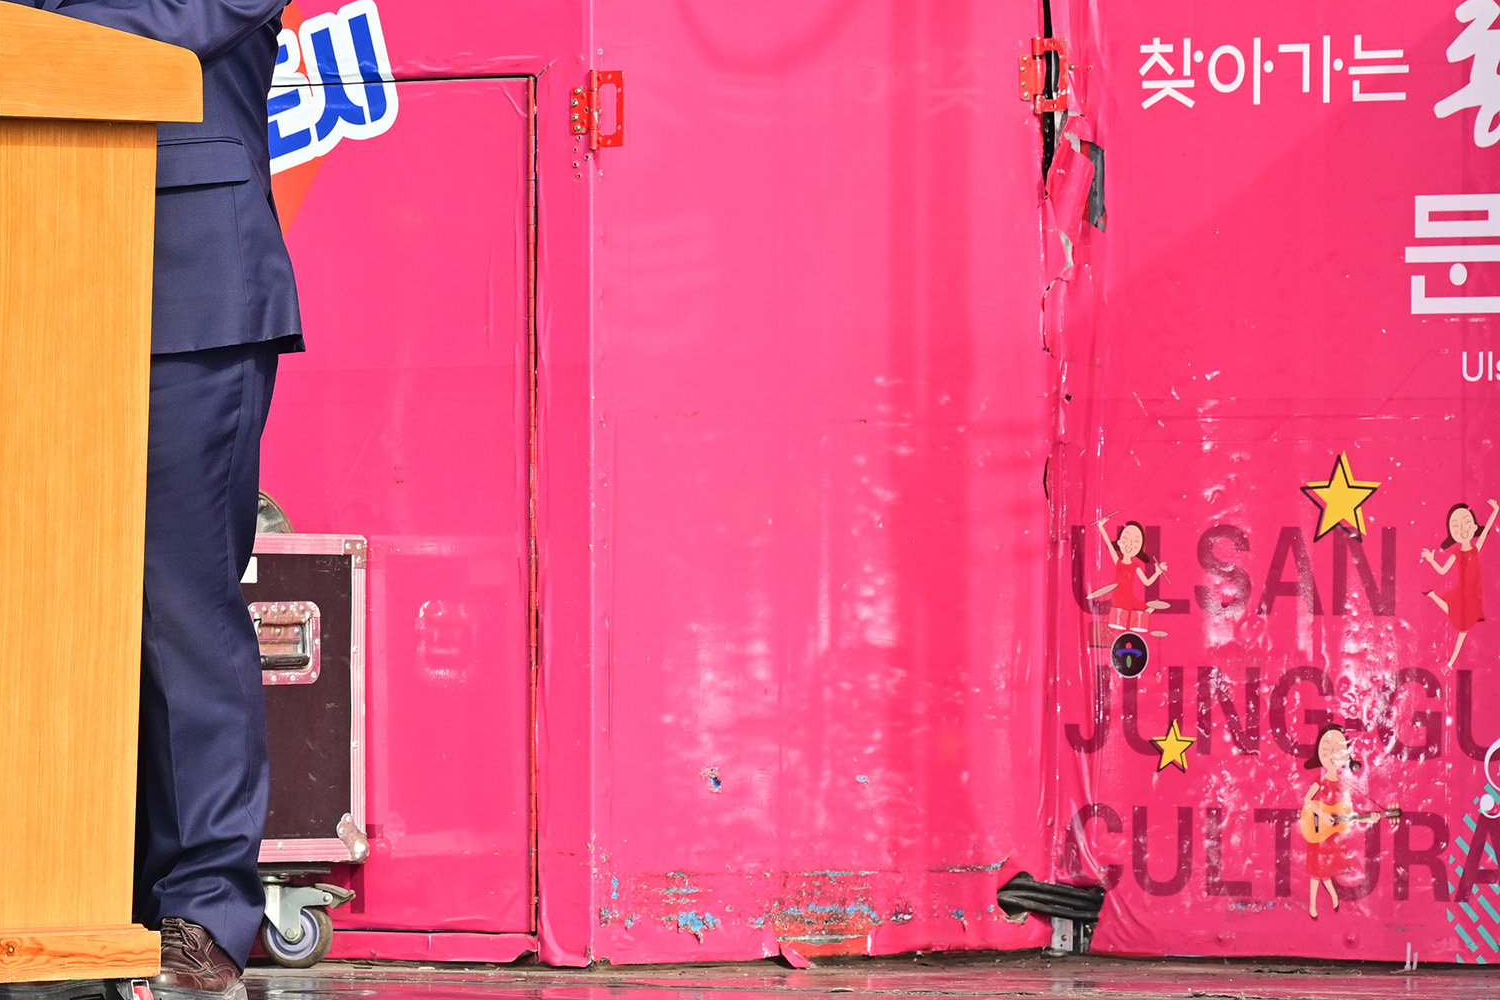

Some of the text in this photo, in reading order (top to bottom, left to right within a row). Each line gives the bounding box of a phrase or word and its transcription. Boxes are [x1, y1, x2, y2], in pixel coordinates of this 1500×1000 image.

[1138, 34, 1410, 110] 찾아가는
[1404, 193, 1500, 316] 문
[1070, 525, 1397, 617] ULSAN
